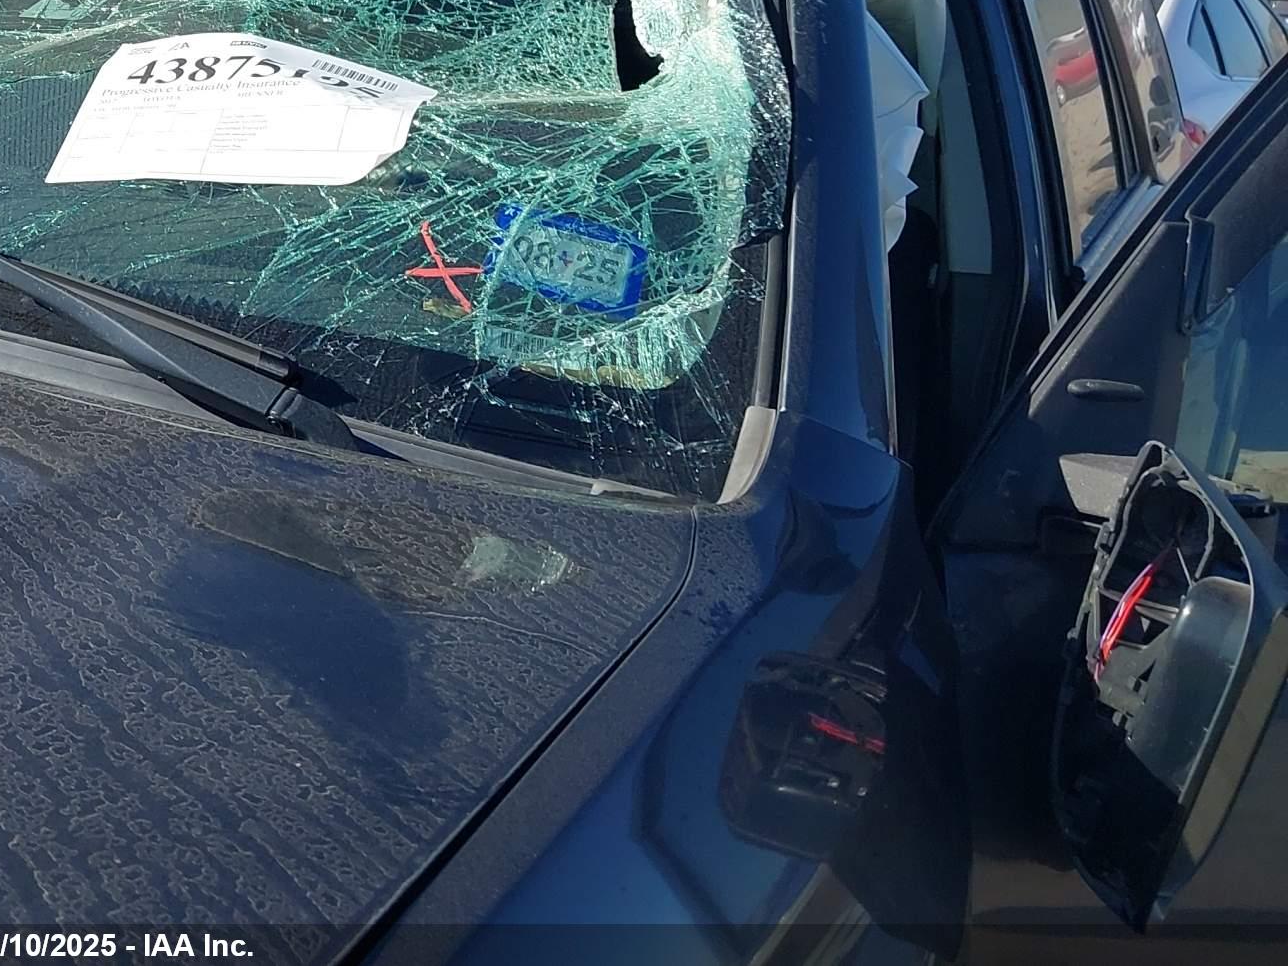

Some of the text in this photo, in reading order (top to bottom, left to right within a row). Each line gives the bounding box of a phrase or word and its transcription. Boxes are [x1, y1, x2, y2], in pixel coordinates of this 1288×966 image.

[102, 79, 302, 98] Progressive Casualty Insurance
[573, 250, 620, 285] 25
